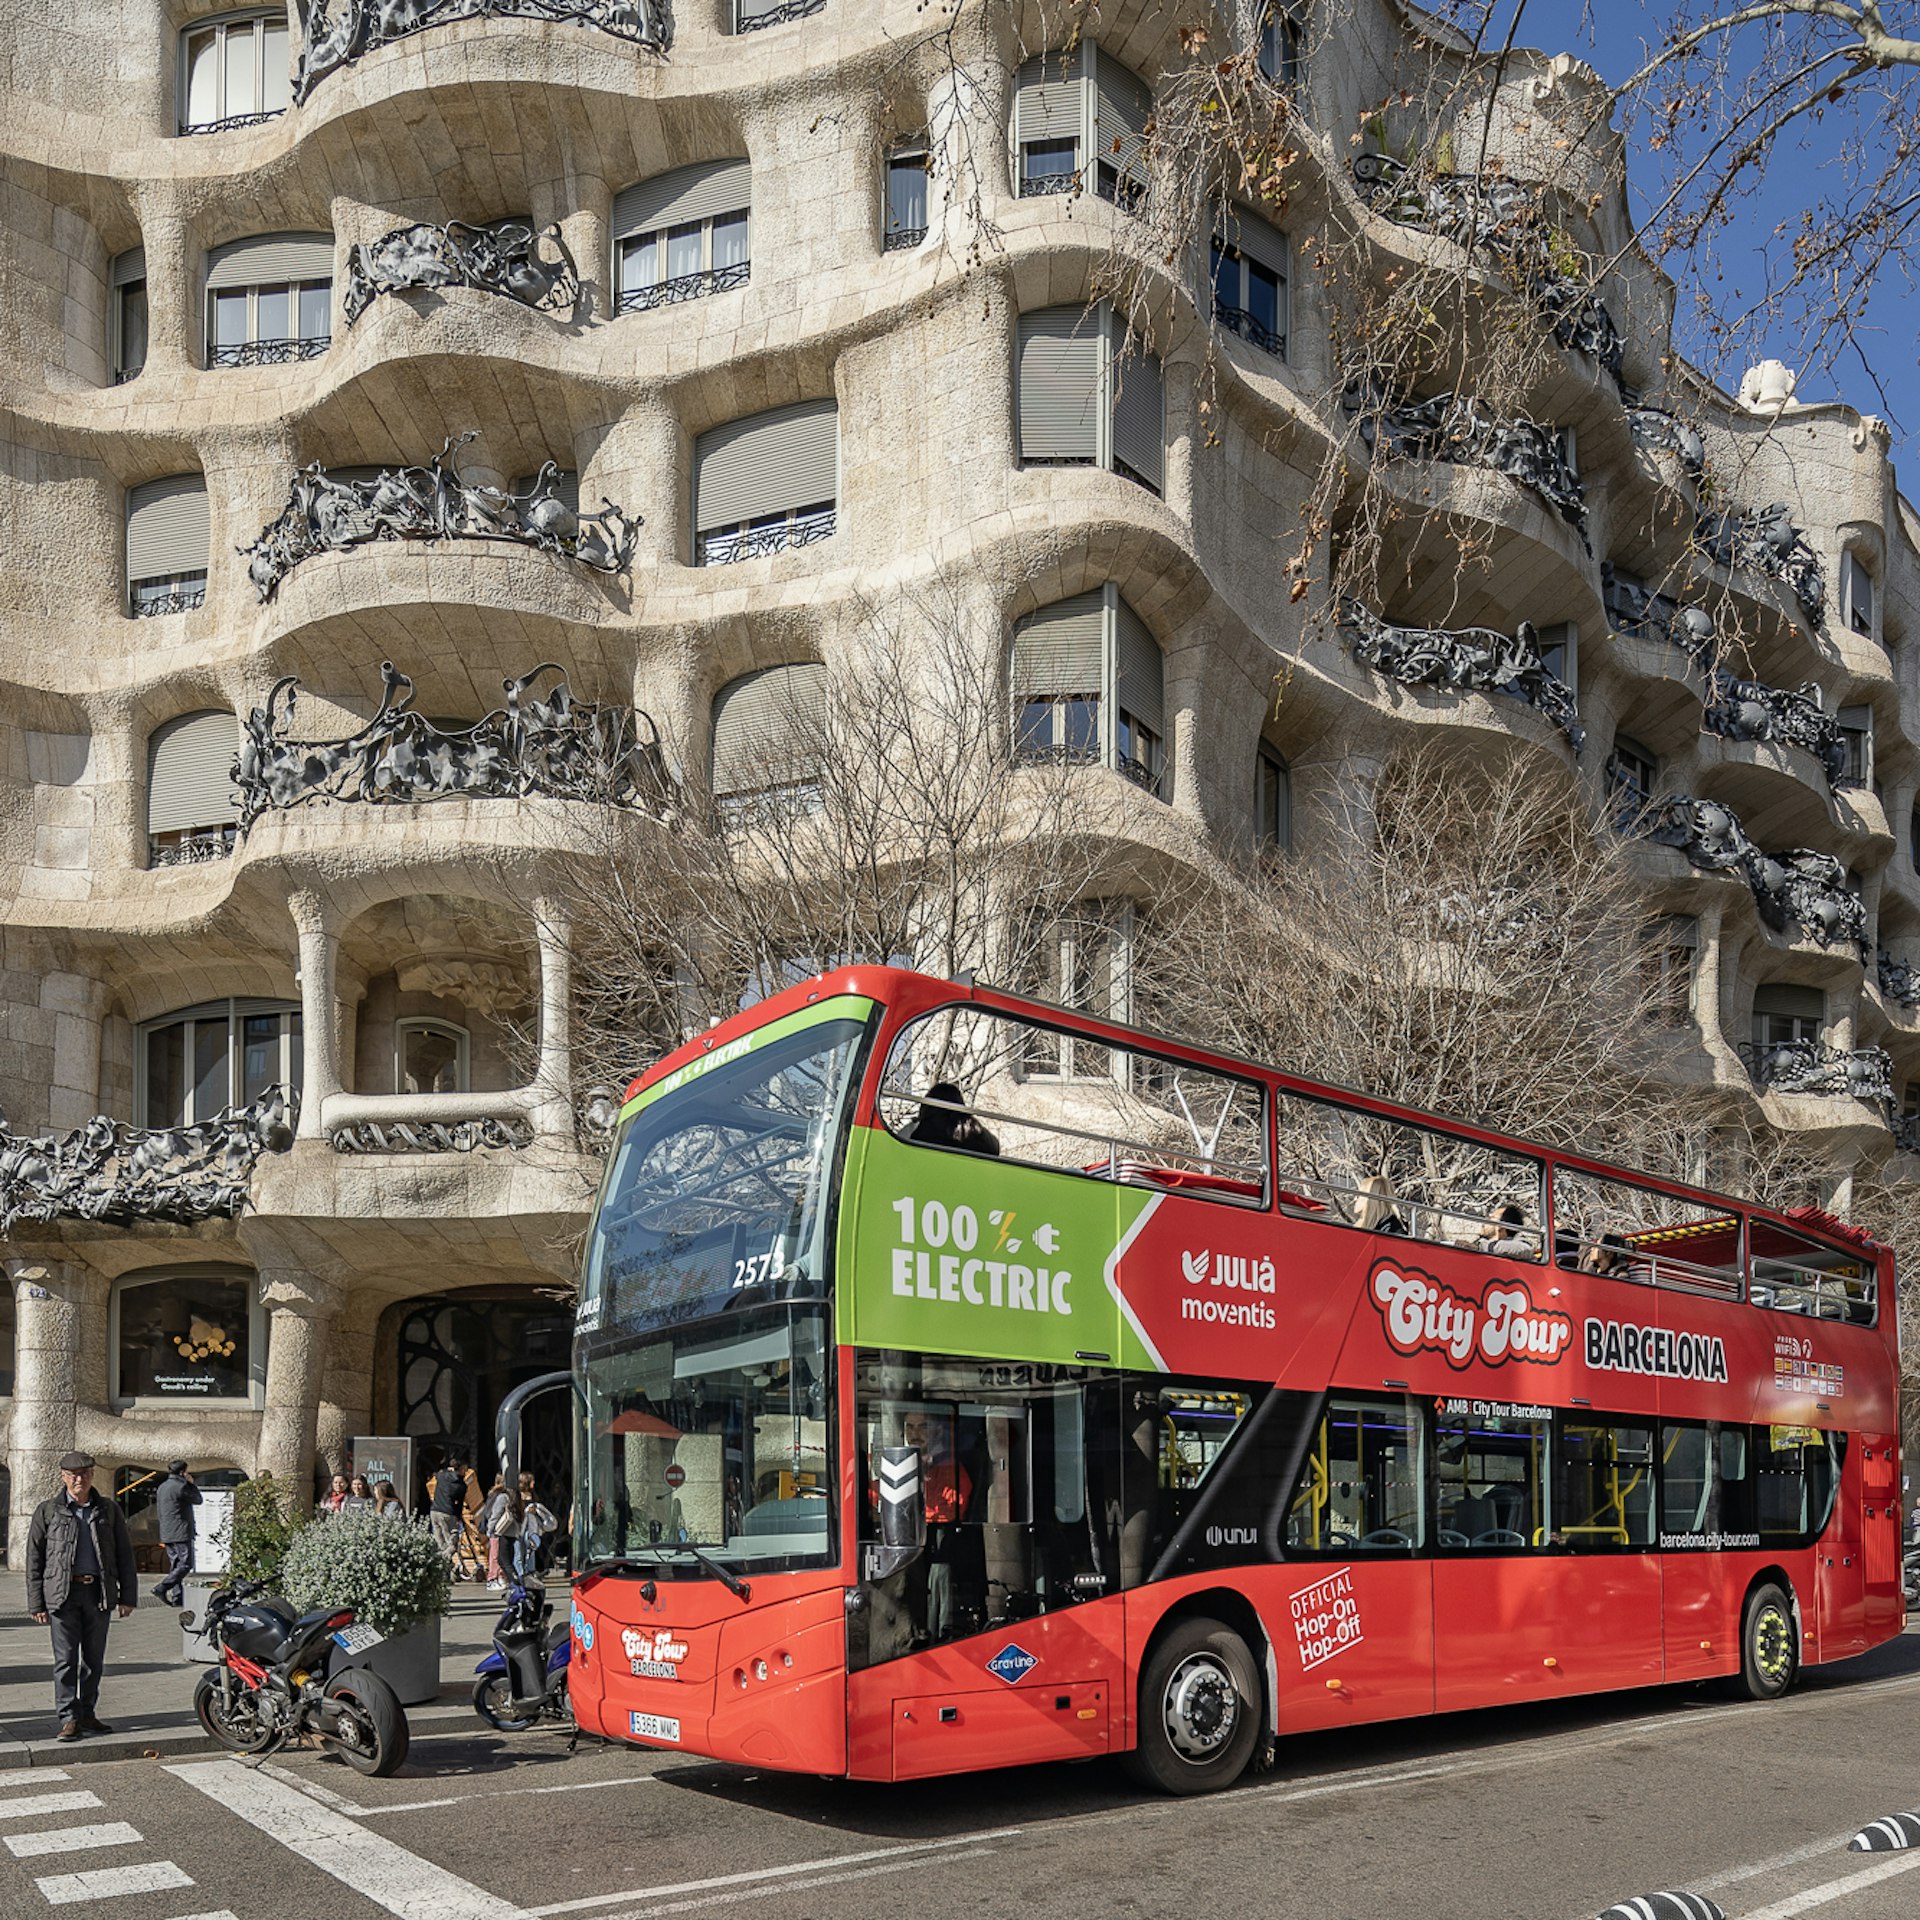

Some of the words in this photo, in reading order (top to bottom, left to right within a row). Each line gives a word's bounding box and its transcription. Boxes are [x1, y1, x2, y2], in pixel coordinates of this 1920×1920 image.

[733, 1251, 785, 1289] 2573
[892, 1248, 1072, 1315] ELECTRIC
[1182, 1297, 1276, 1329] moventis
[1375, 1269, 1475, 1360] City
[1481, 1290, 1568, 1357] Tour
[1585, 1317, 1728, 1384] BARCELONA
[1447, 1399, 1469, 1414] AMB
[1473, 1400, 1491, 1418] City
[1491, 1402, 1510, 1416] Tour
[1511, 1404, 1552, 1419] Barcelona
[367, 1460, 386, 1472] ALL
[1660, 1531, 1759, 1550] barcelona.city-tour.com
[1291, 1573, 1354, 1618] OFFICIAL
[1294, 1598, 1357, 1641] Hop-On
[621, 1629, 652, 1661] City
[653, 1632, 689, 1661] Tour
[1299, 1614, 1361, 1665] Hop-Off
[631, 1658, 678, 1680] BARCELONA
